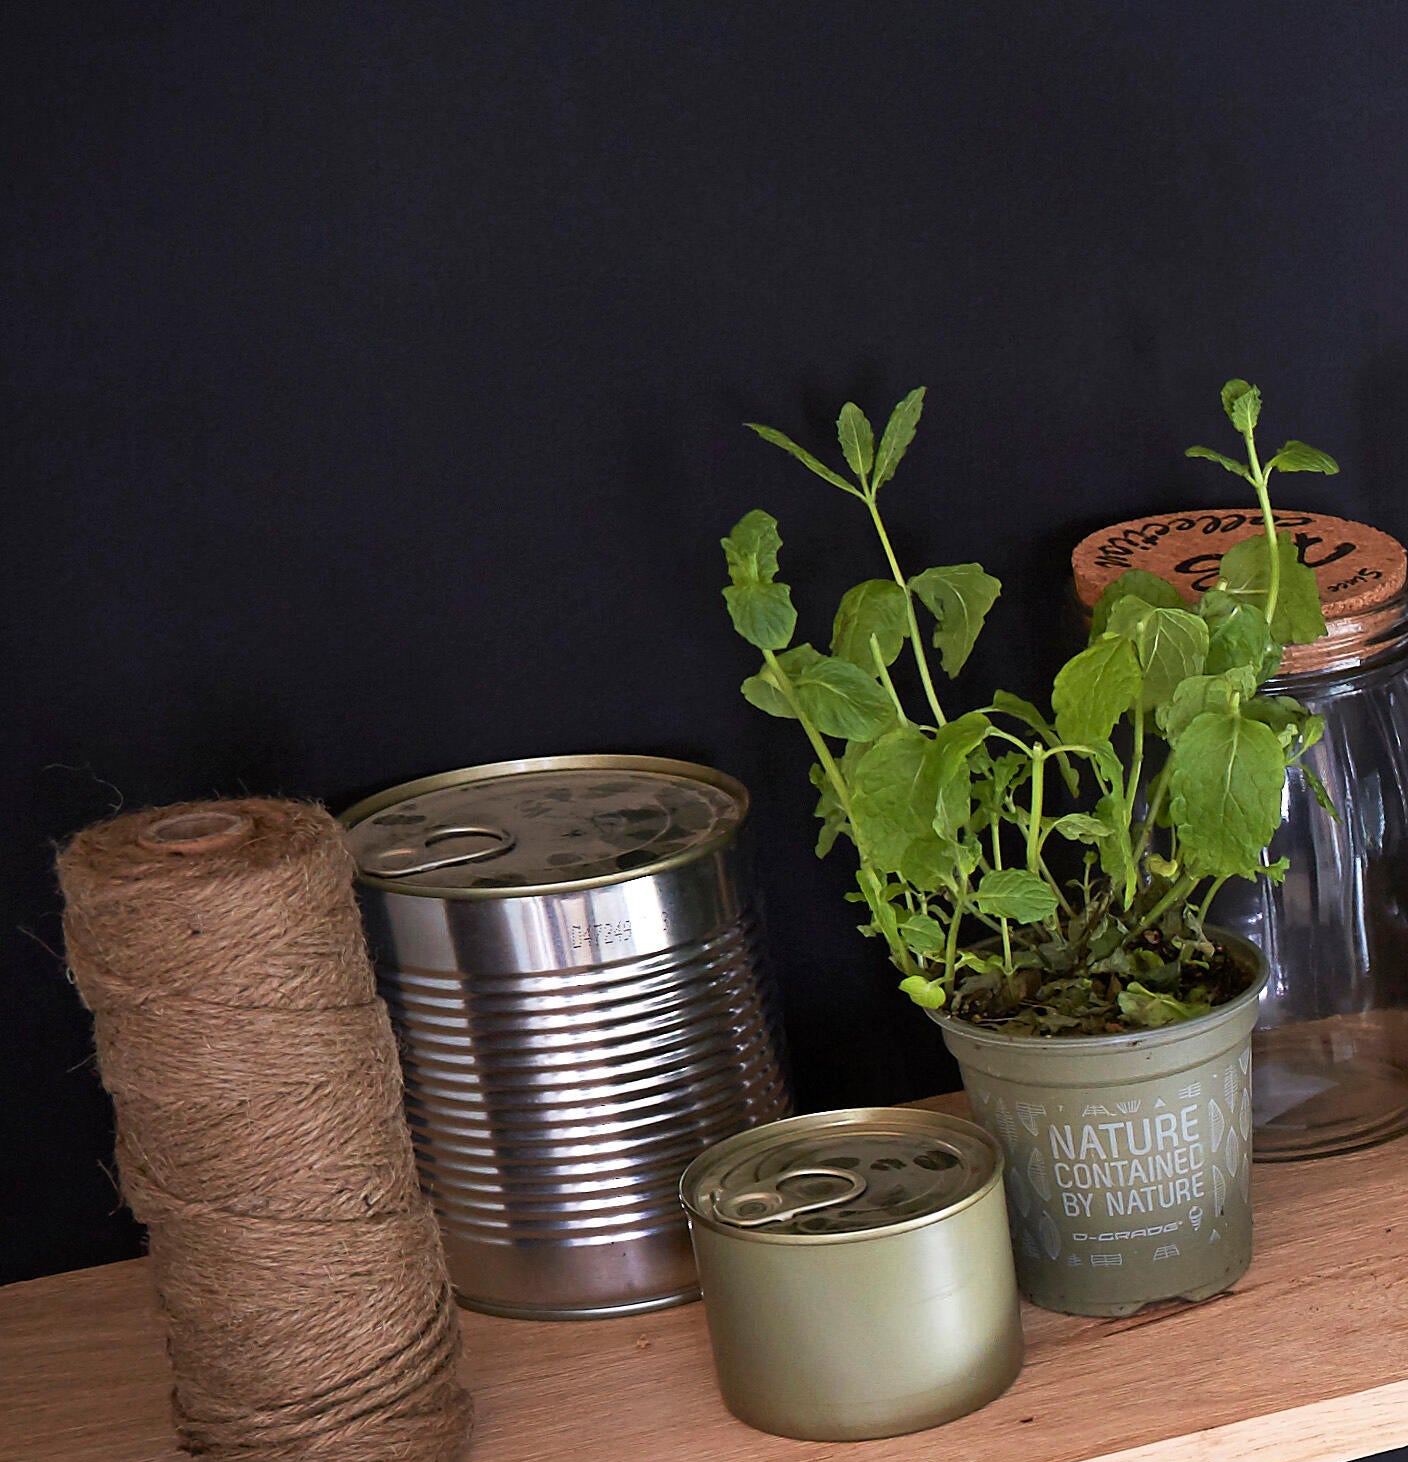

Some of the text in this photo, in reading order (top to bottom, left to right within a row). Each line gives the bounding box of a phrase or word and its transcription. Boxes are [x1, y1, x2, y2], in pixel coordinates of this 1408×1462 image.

[1049, 1103, 1201, 1160] NATURE
[1053, 1142, 1205, 1189] CONTAINED
[1061, 1171, 1206, 1217] BY NATURE
